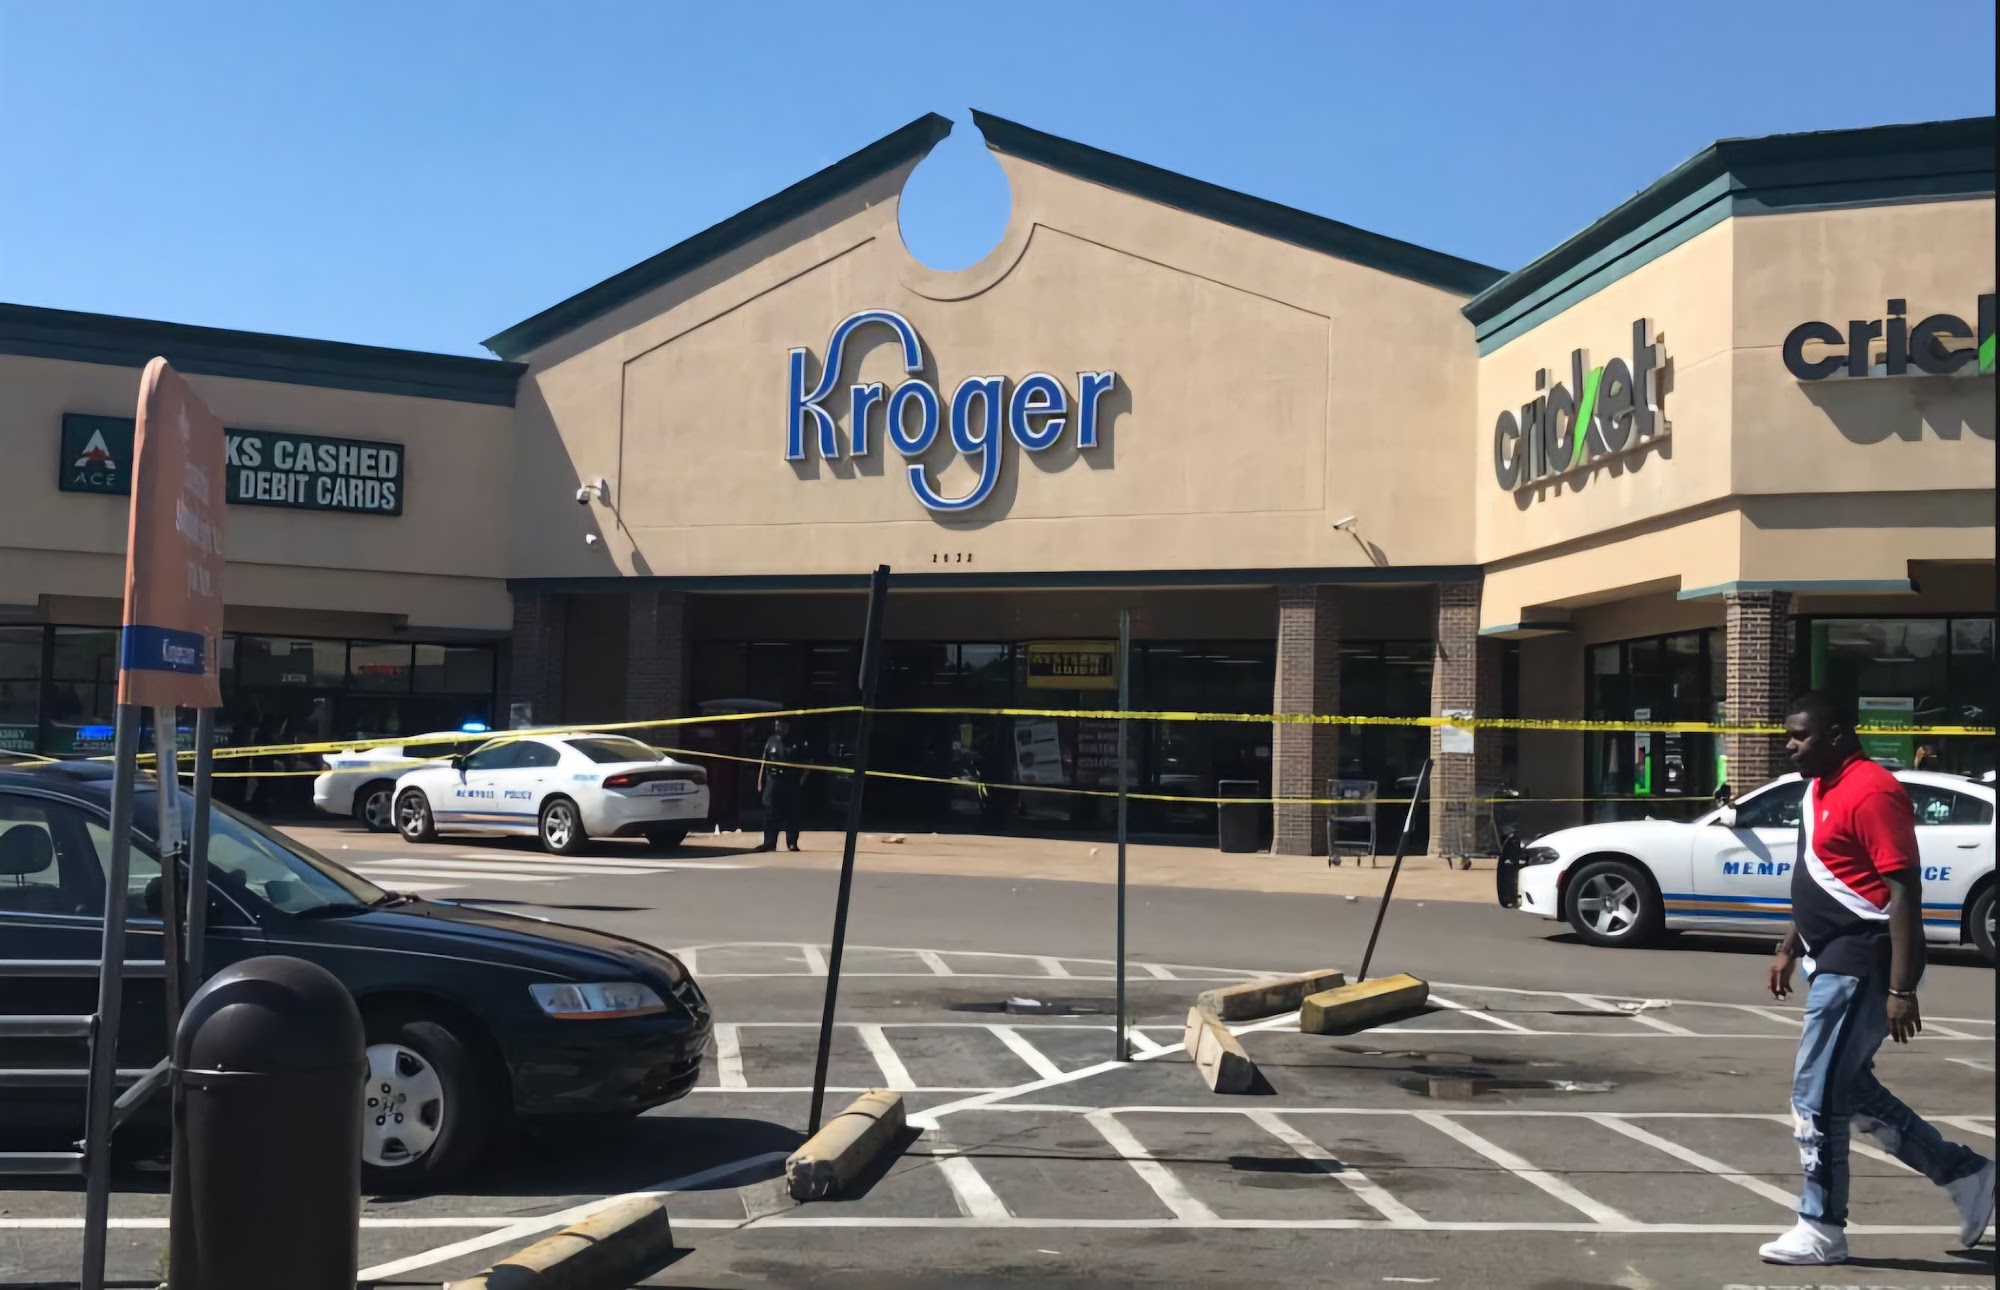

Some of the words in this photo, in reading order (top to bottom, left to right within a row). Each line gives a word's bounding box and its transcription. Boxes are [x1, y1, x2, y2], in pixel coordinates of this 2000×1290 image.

[784, 308, 1117, 512] Kroger
[1494, 317, 1656, 492] cricket
[73, 471, 116, 486] ACE
[273, 440, 399, 479] CASHED
[239, 469, 310, 503] DEBIT
[315, 475, 397, 510] CARDS
[1722, 861, 1792, 877] MEMP
